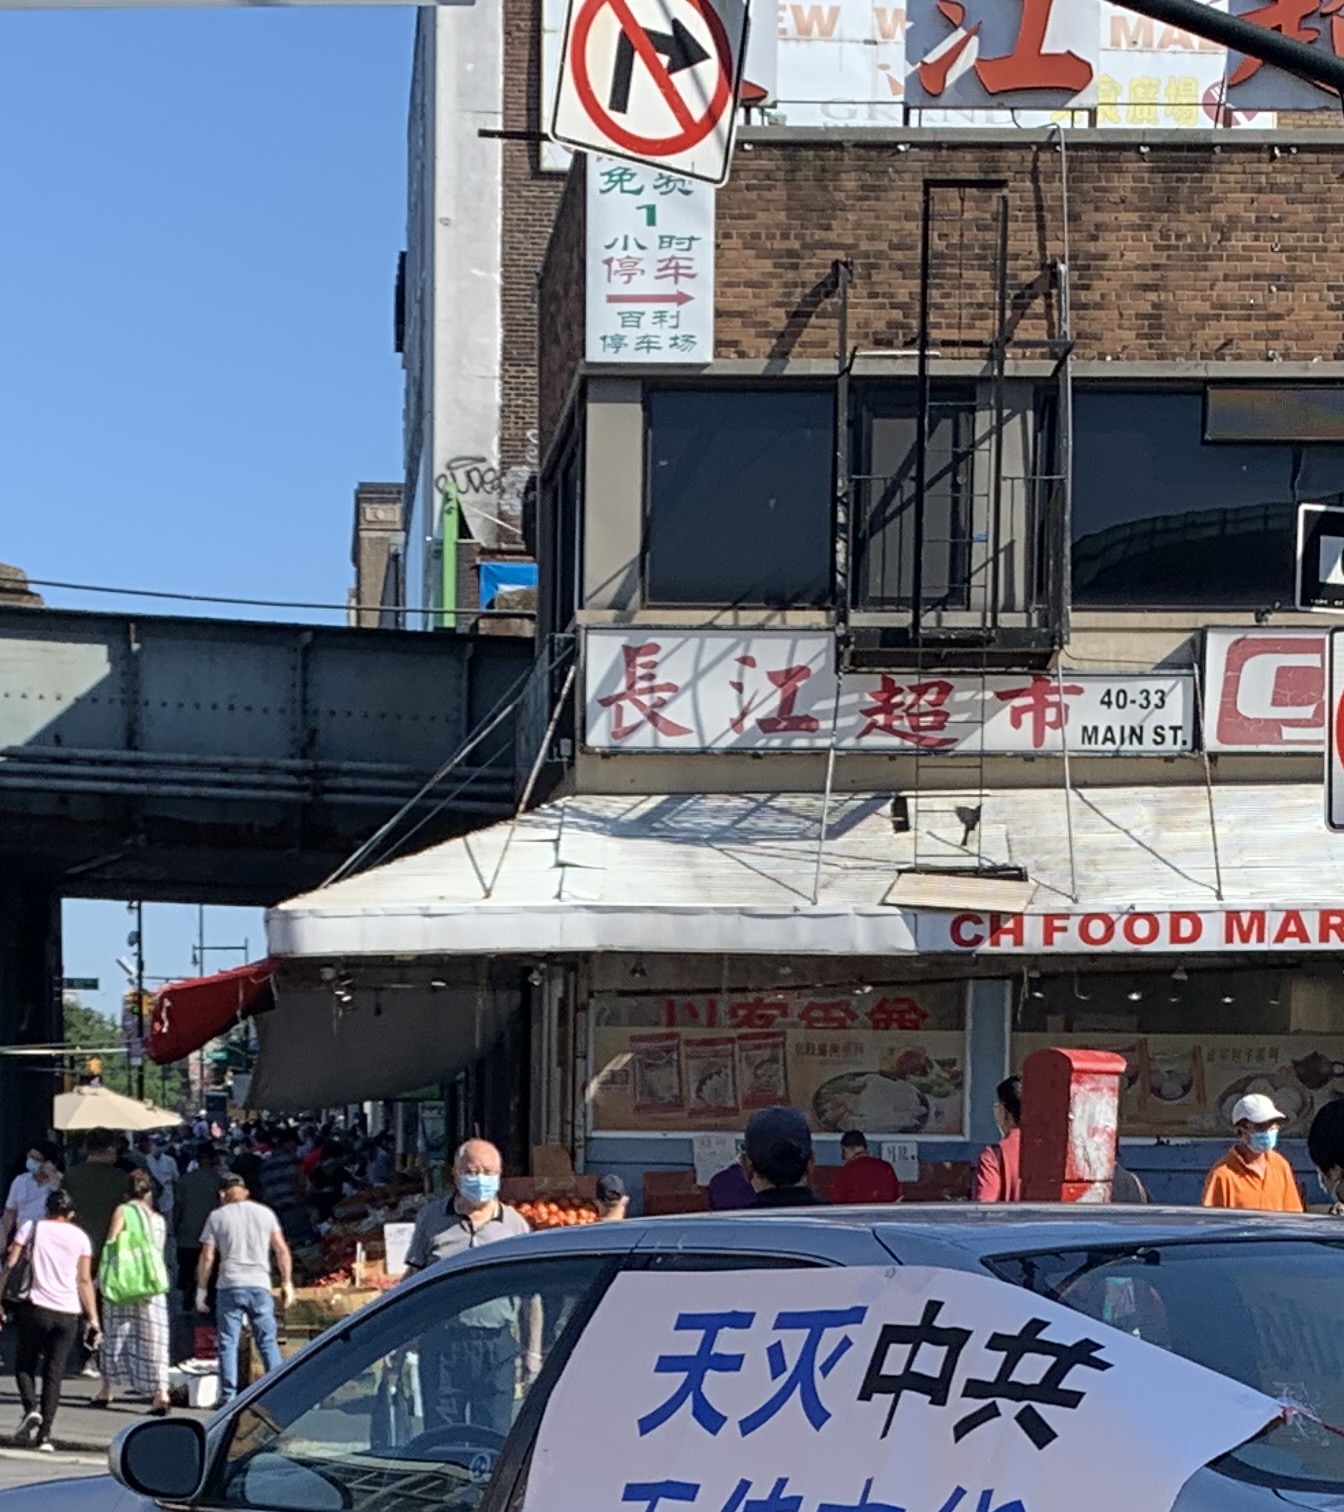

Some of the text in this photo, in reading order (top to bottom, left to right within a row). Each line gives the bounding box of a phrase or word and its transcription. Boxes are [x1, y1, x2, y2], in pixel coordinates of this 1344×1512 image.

[635, 204, 657, 226] 1
[605, 234, 701, 251] 小时
[602, 255, 698, 285] 停车
[600, 334, 698, 354] 停车场
[597, 642, 1086, 749] 長江超市
[1100, 688, 1167, 711] 40-33
[1081, 725, 1188, 747] MAIN ST.
[1042, 910, 1203, 946] FOOD
[637, 1299, 1116, 1451] 天灭中共
